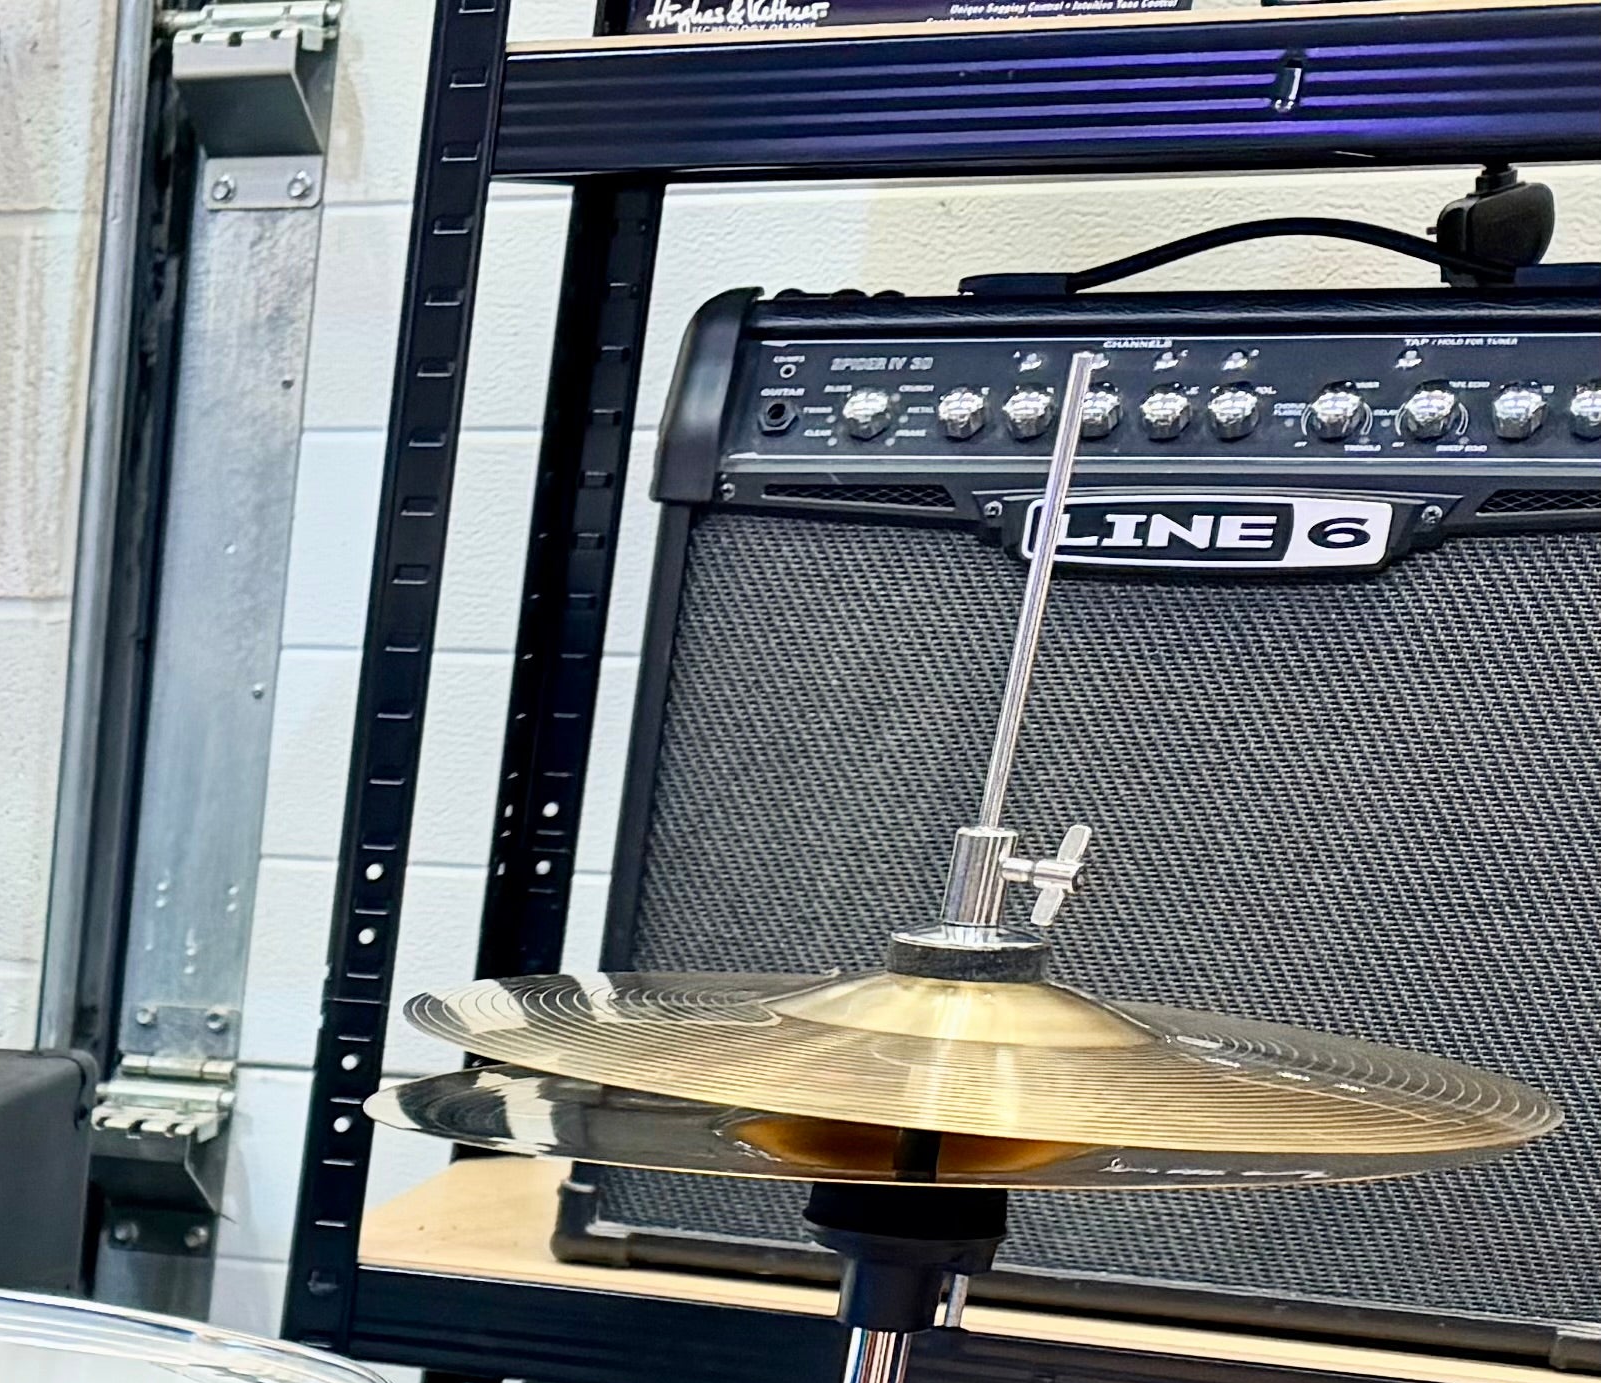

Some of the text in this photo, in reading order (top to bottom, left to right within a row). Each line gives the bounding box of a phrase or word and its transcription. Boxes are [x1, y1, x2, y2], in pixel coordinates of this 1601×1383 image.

[647, 0, 724, 33] Hughes
[726, 0, 745, 24] &
[1055, 513, 1372, 550] LINE 6
